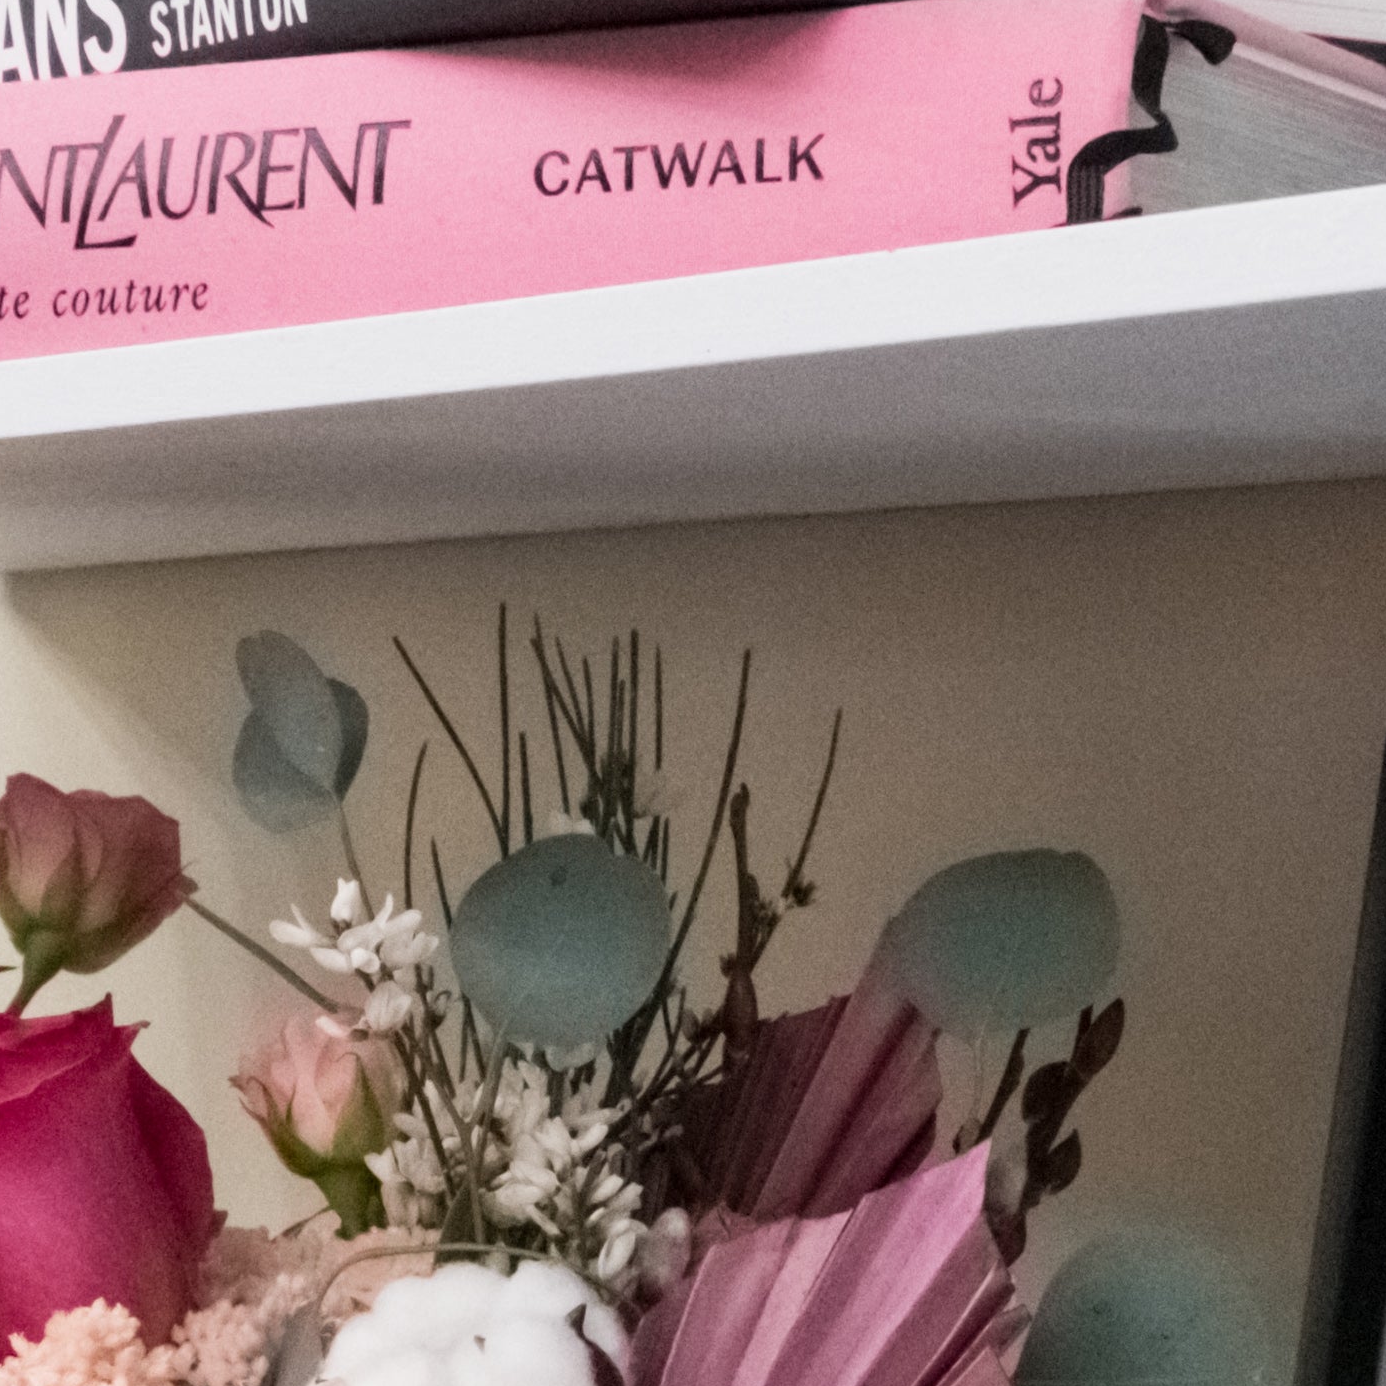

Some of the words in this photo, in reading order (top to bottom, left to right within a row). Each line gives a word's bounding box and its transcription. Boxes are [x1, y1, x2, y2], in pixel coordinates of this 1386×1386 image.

[533, 133, 826, 197] CATWALK
[1008, 76, 1065, 209] Yale
[51, 279, 210, 316] couture
